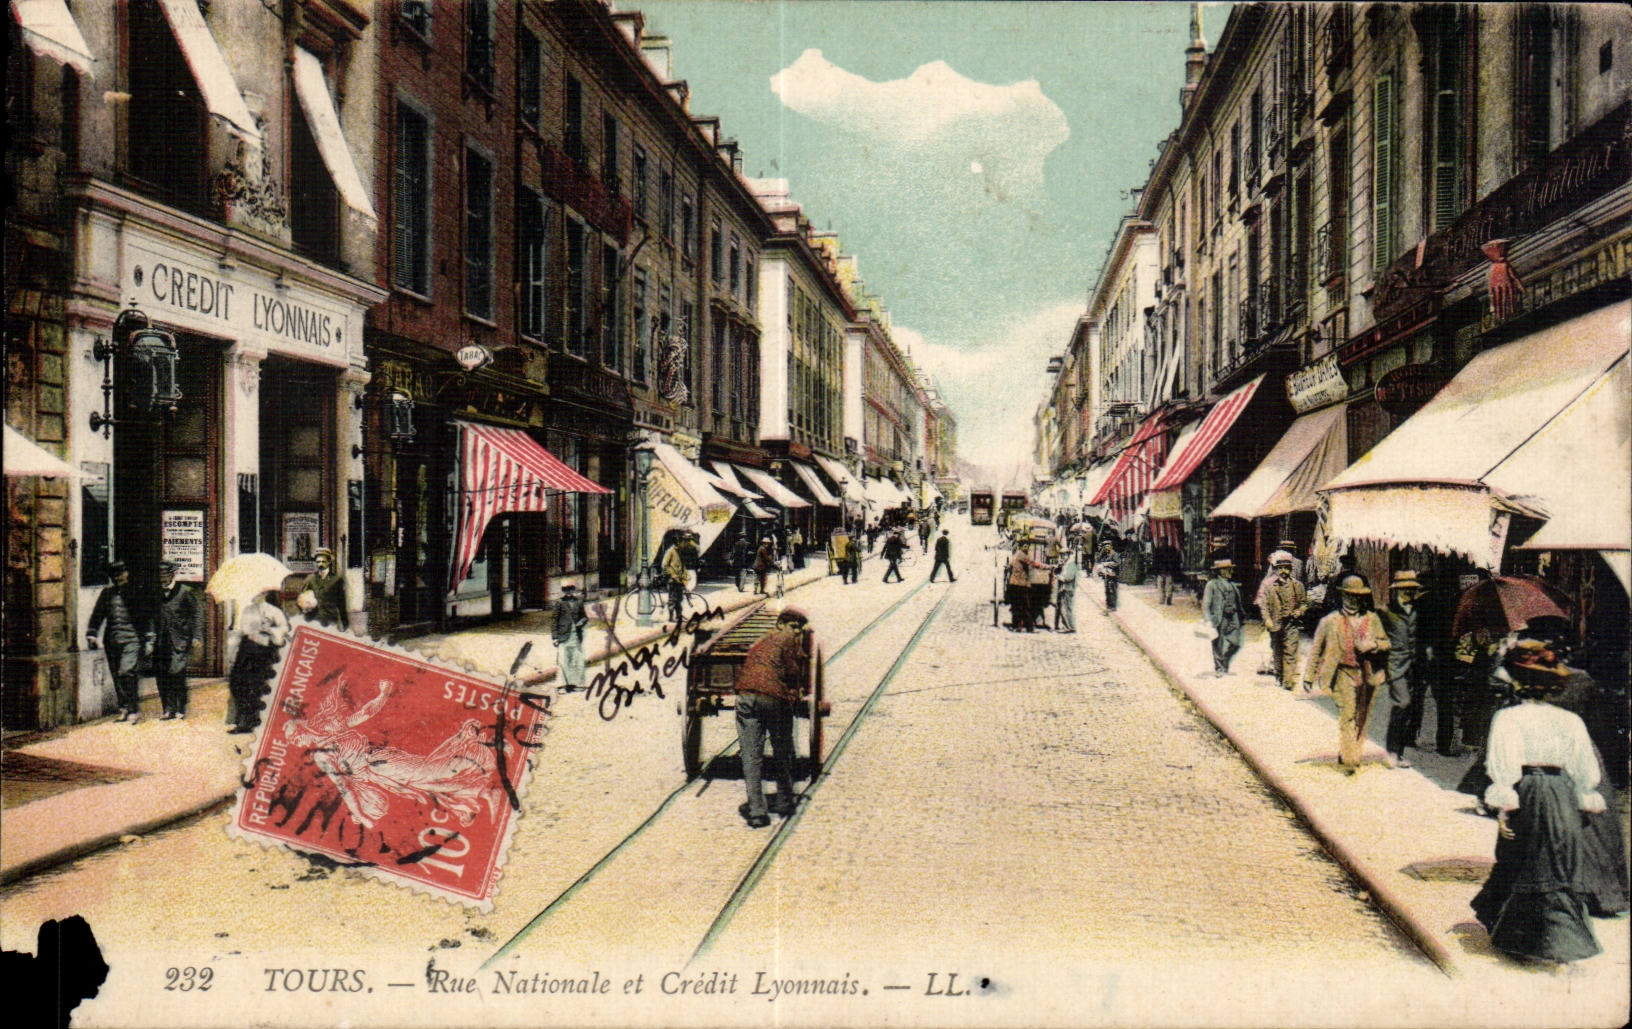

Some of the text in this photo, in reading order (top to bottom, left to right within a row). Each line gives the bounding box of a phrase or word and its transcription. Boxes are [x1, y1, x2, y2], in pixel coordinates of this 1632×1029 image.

[151, 263, 331, 347] CREDIT LYONNAIS
[443, 681, 524, 720] POSTES
